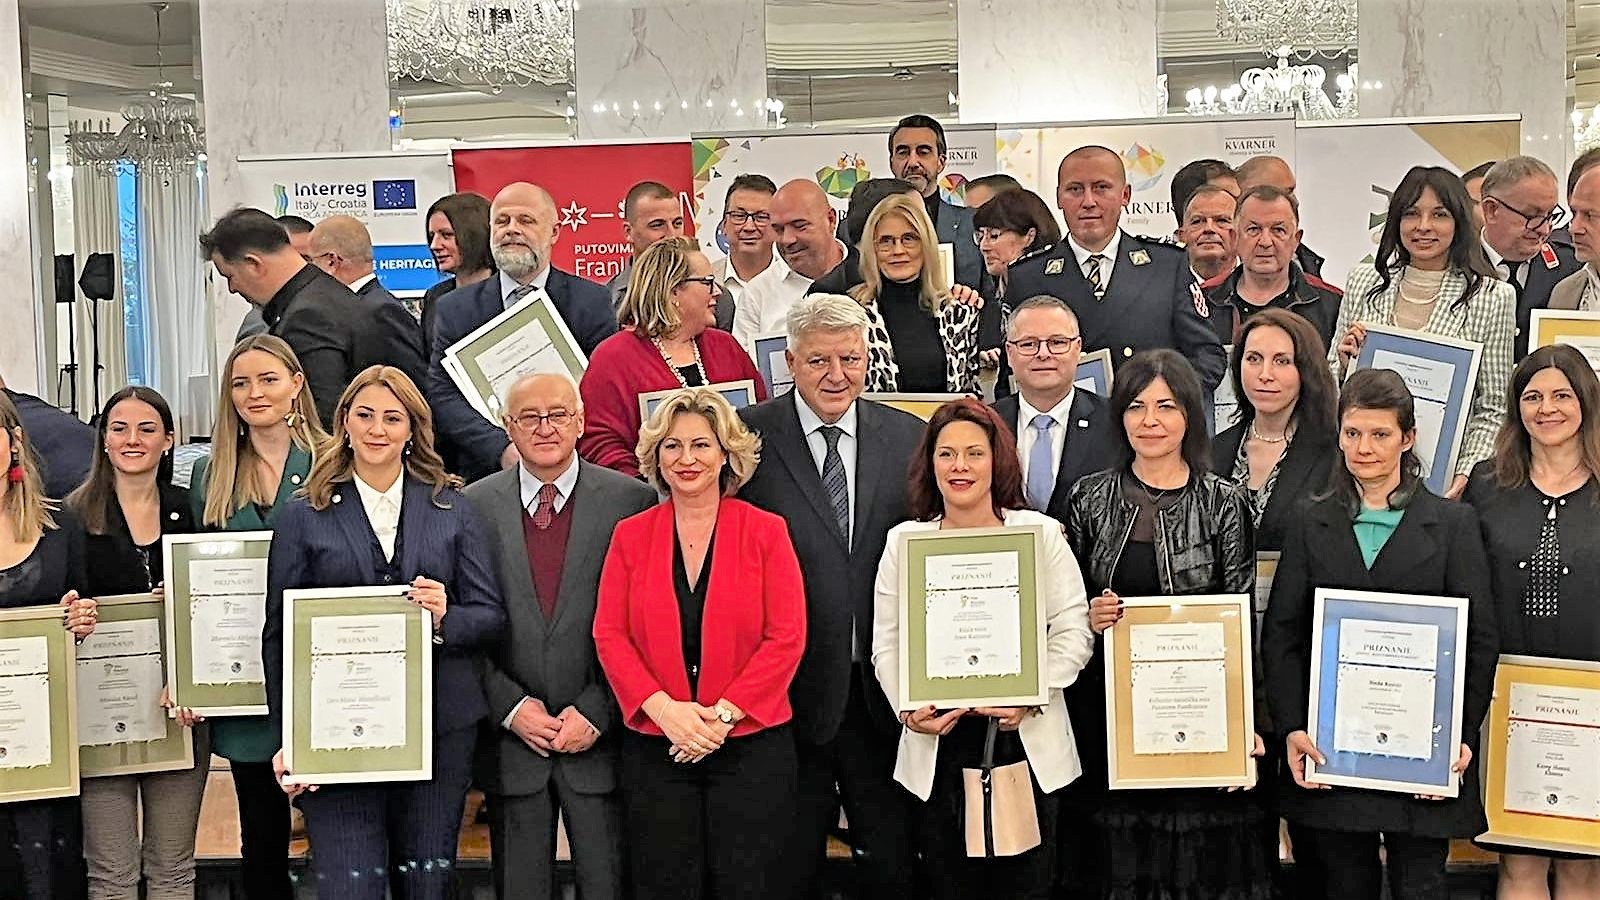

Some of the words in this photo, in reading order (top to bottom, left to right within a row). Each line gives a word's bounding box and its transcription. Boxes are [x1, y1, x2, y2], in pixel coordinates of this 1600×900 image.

[1225, 140, 1276, 150] KVARNER
[948, 151, 978, 160] RNER
[294, 182, 367, 198] Interreg
[295, 201, 319, 212] Italy
[327, 199, 367, 209] Croatia
[1121, 201, 1176, 215] ARNER
